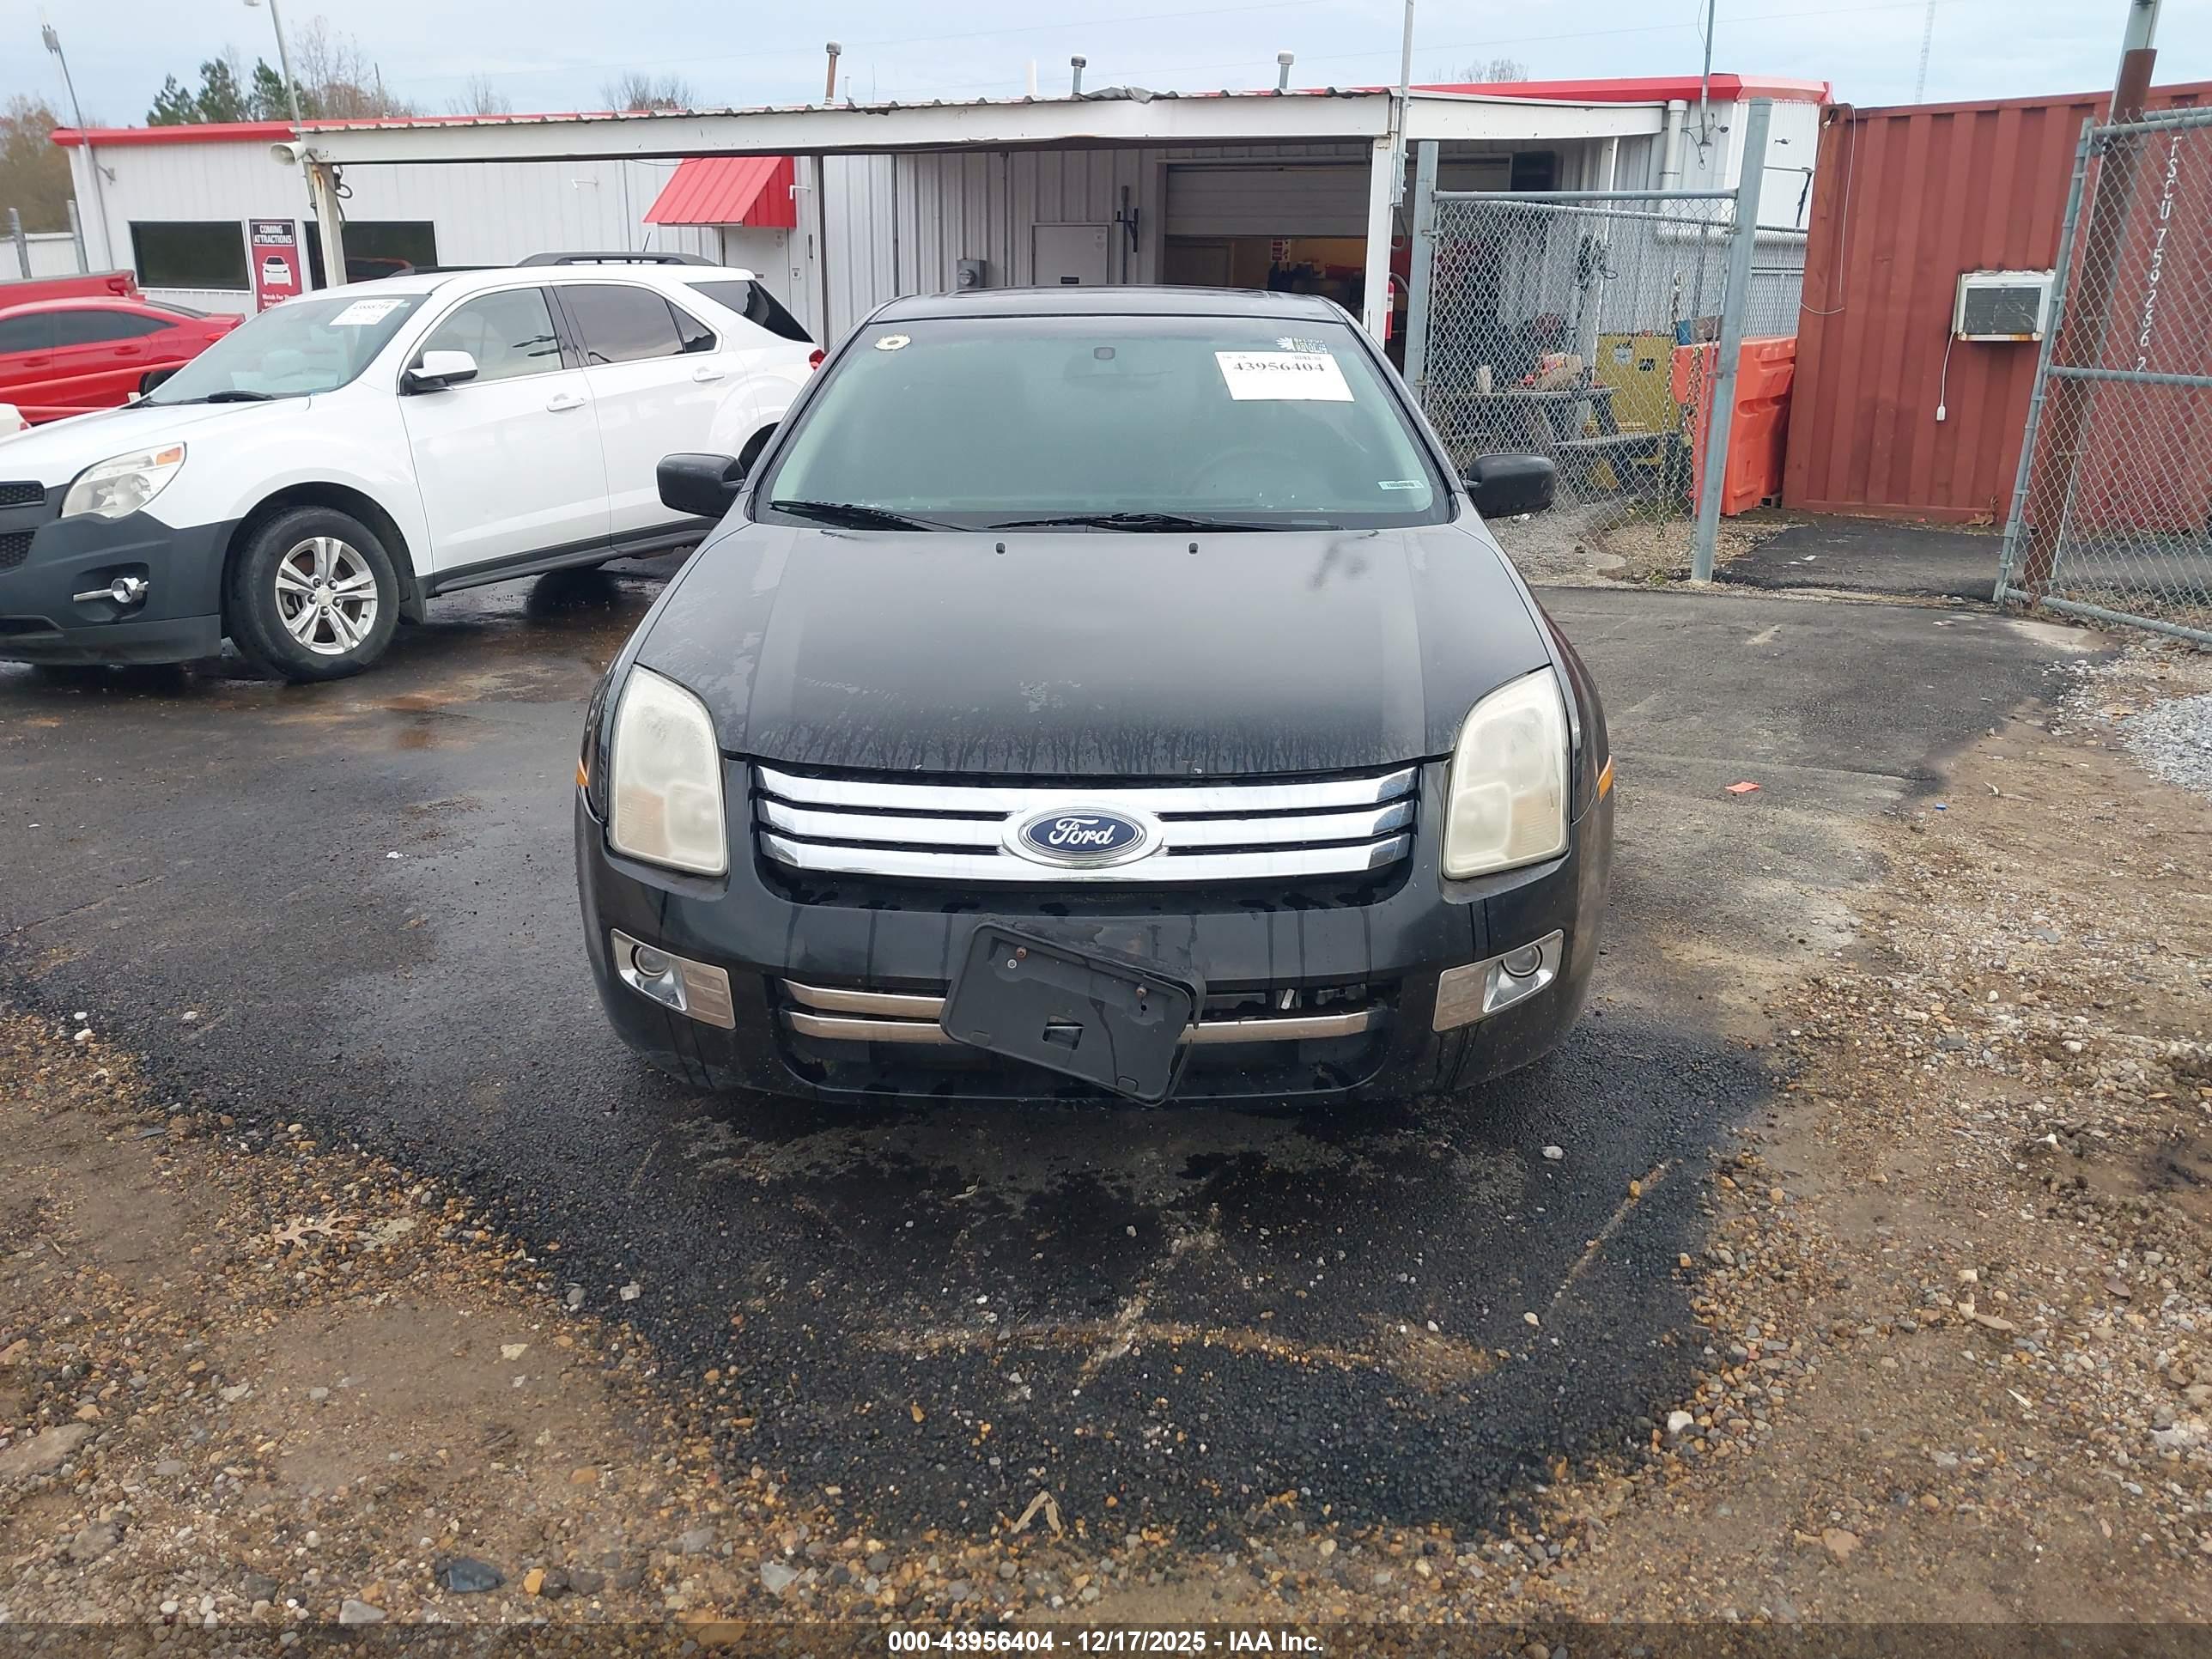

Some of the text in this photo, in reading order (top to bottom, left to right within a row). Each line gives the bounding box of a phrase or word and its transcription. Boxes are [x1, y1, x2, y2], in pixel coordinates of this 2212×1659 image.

[259, 225, 283, 234] COMING
[254, 234, 293, 244] ATTRACTIONS
[1233, 362, 1325, 372] 43956404
[1048, 817, 1115, 845] Ford
